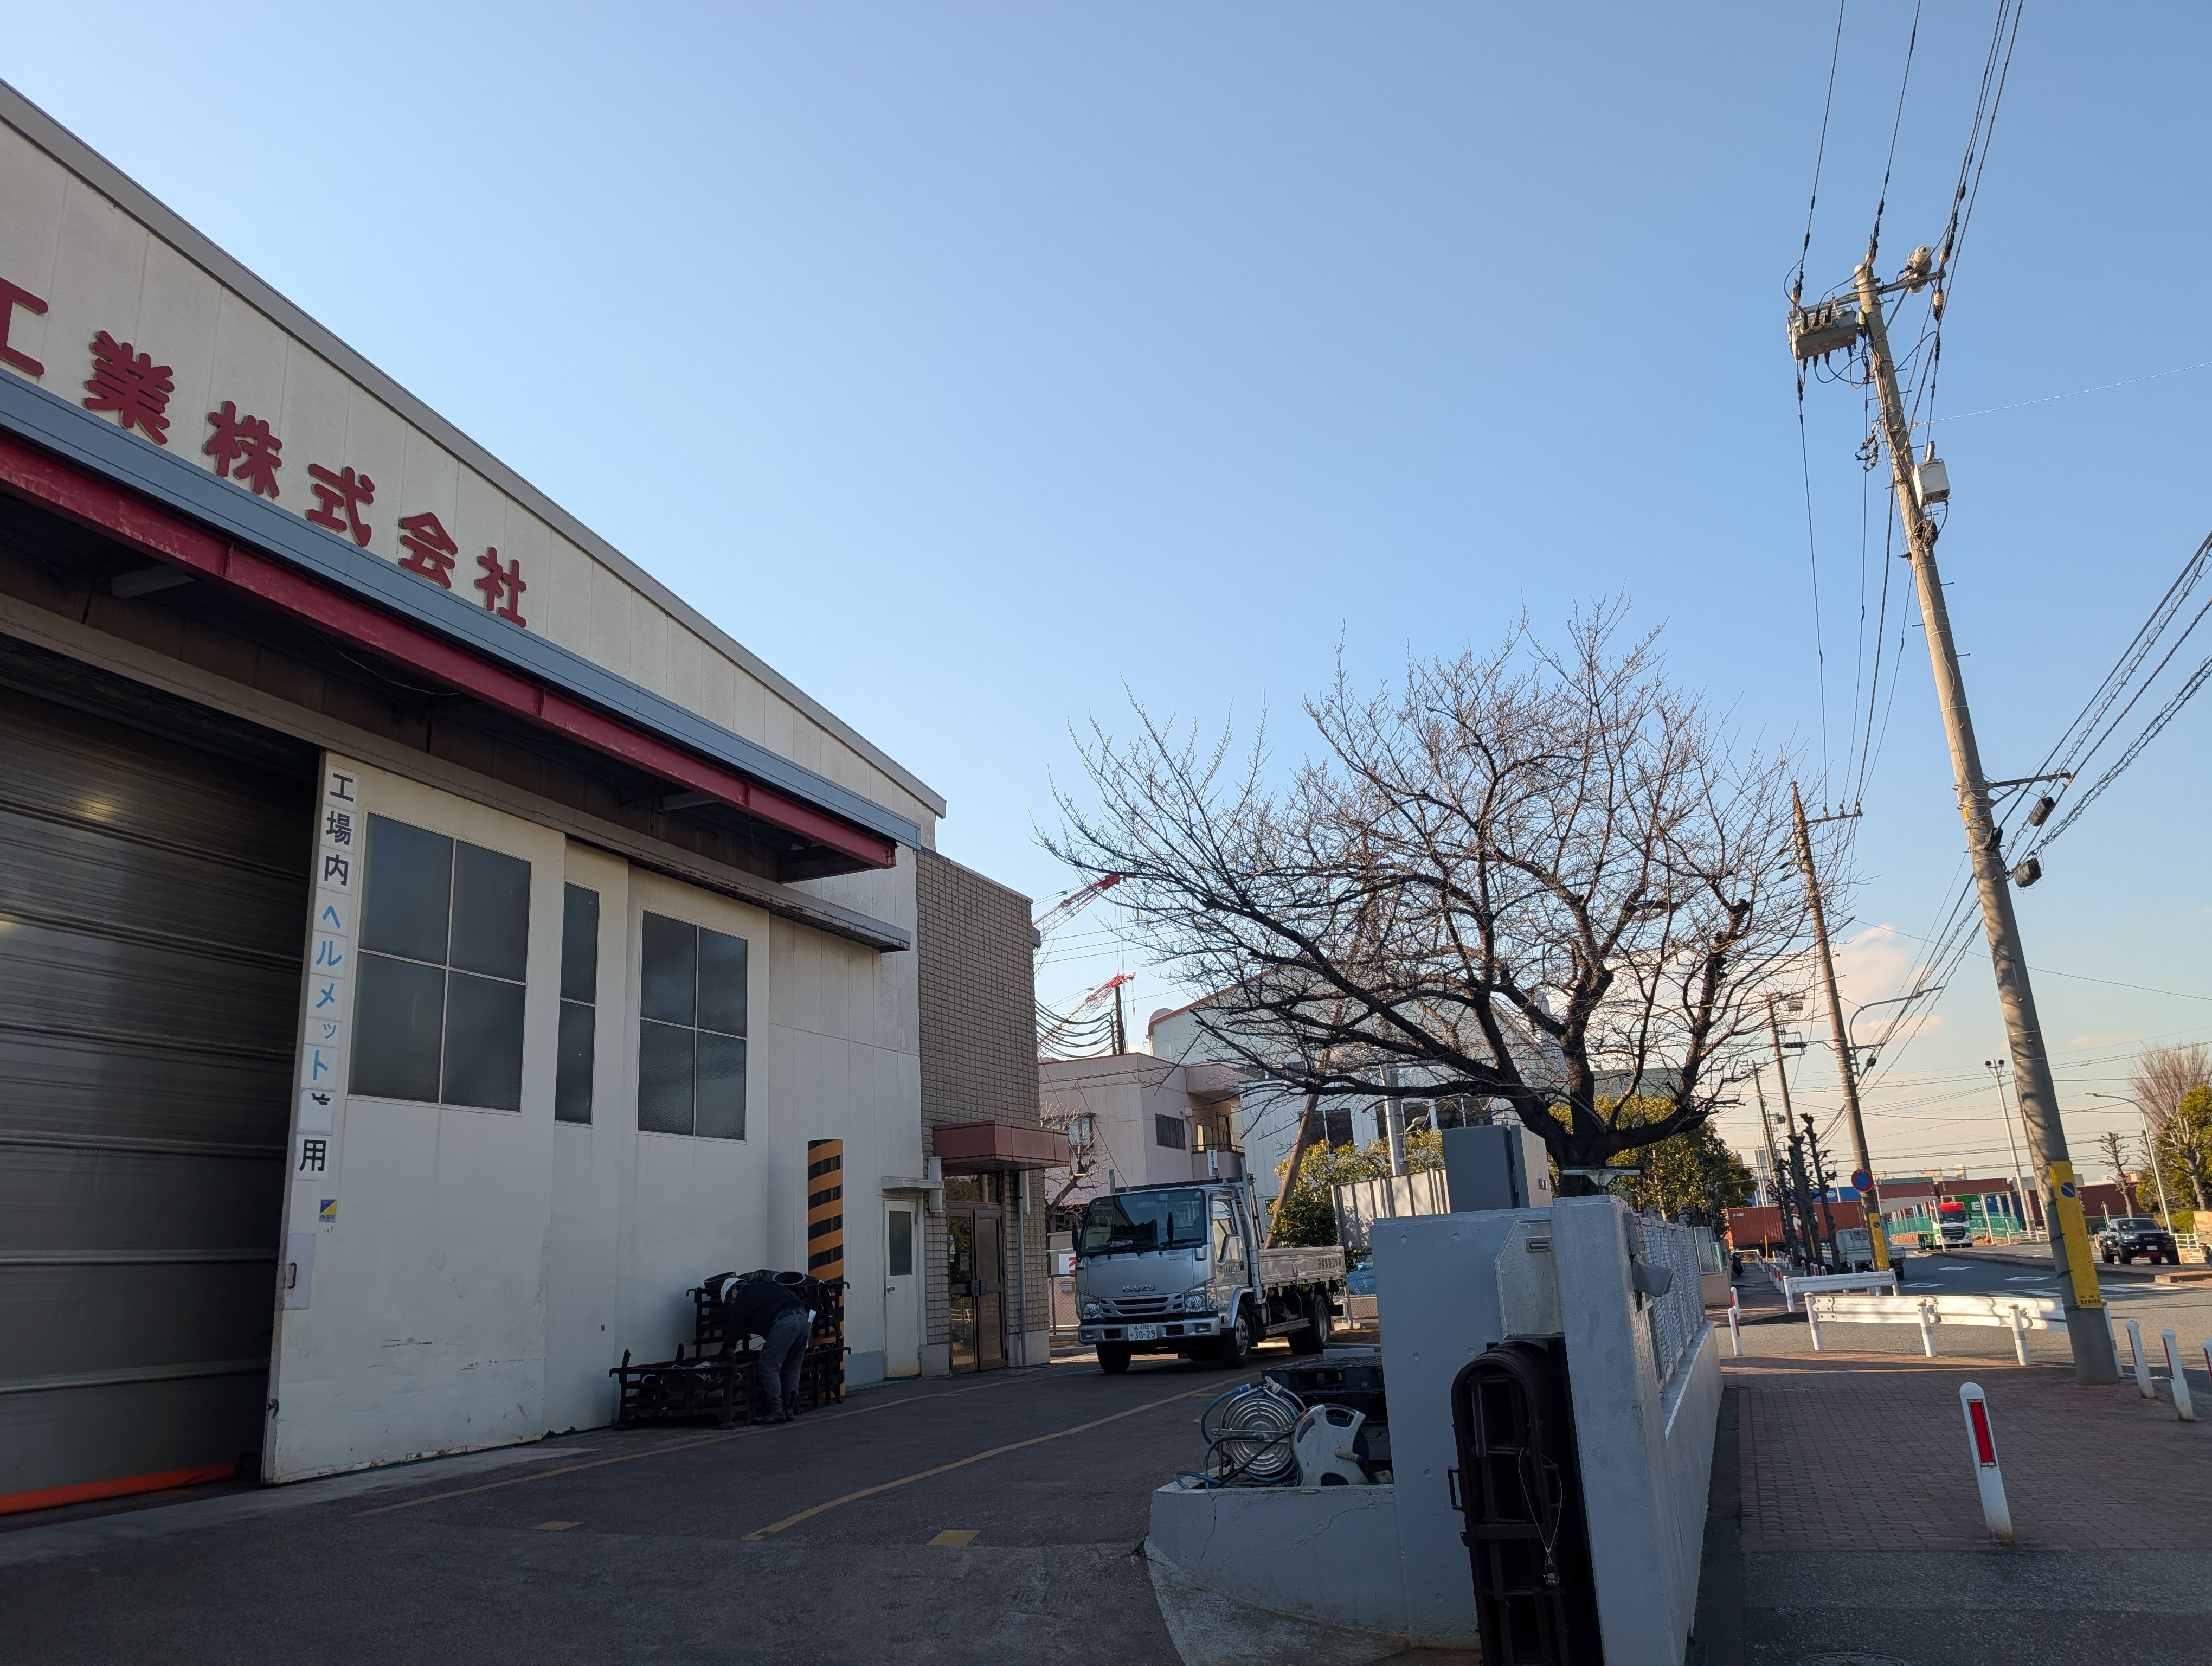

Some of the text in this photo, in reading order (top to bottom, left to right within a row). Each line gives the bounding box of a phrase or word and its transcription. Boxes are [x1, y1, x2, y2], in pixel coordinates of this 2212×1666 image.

[299, 773, 355, 1172] 工場内ヘルメット用
[1123, 1284, 1156, 1293] ISUZU
[1134, 1330, 1155, 1340] 30-29
